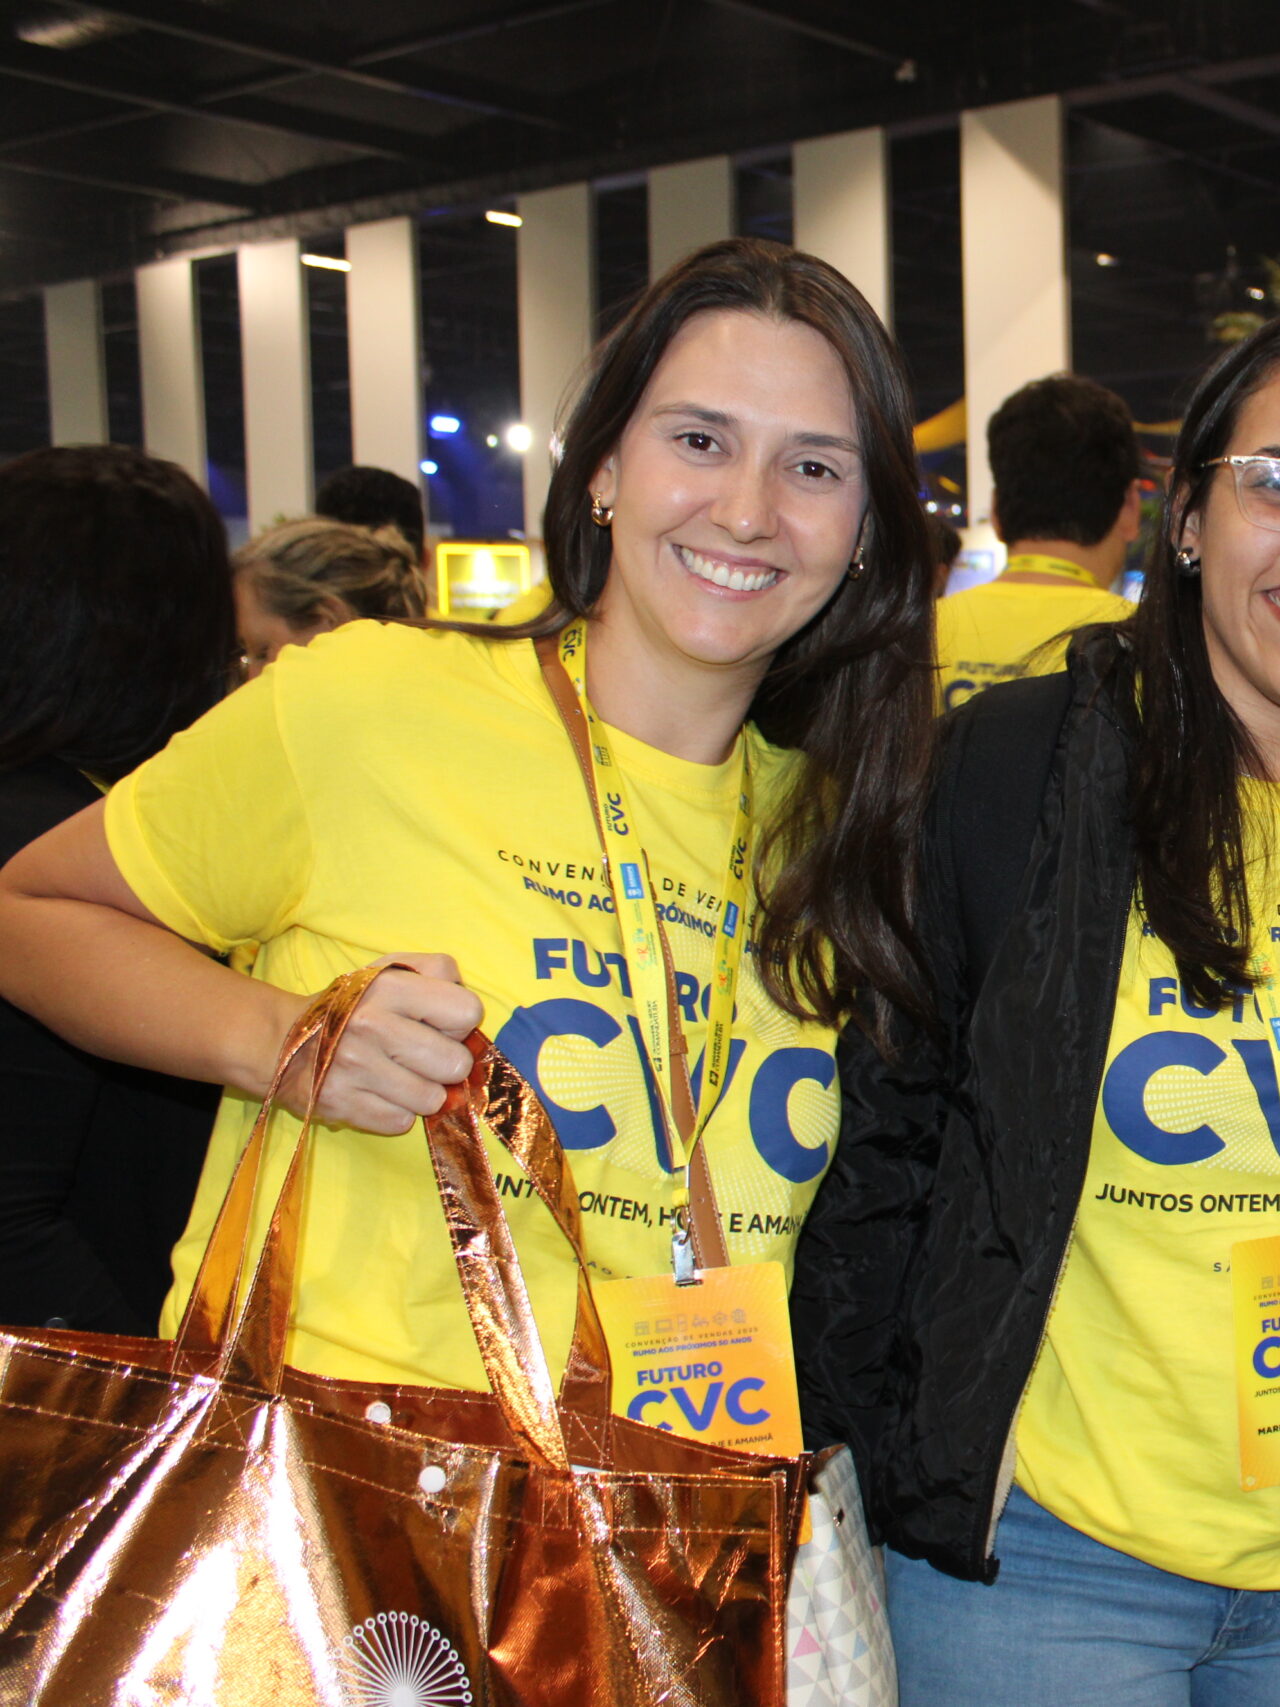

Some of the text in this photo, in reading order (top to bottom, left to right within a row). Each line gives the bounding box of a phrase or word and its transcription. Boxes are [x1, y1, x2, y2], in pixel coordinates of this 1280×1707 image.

[607, 792, 629, 836] CVC
[498, 850, 606, 887] CONVEN
[663, 877, 686, 897] DE
[733, 837, 747, 880] CVC
[523, 876, 583, 909] RUMO
[588, 897, 616, 914] AO
[494, 998, 836, 1184] CVC
[578, 1191, 652, 1228] ONTEM,
[729, 1213, 743, 1233] E
[1096, 1183, 1193, 1214] JUNTOS
[1259, 1300, 1279, 1308] RUMO
[625, 1336, 680, 1349] CONVENÇÃO
[699, 1330, 733, 1339] VENDAS
[633, 1348, 657, 1358] RUMO
[658, 1346, 675, 1354] AOS
[675, 1340, 717, 1352] PRÓXIMOS
[730, 1336, 753, 1345] ANOS
[637, 1361, 723, 1386] FUTURO
[627, 1377, 771, 1432] CVC
[735, 1432, 773, 1446] AMANHÃ
